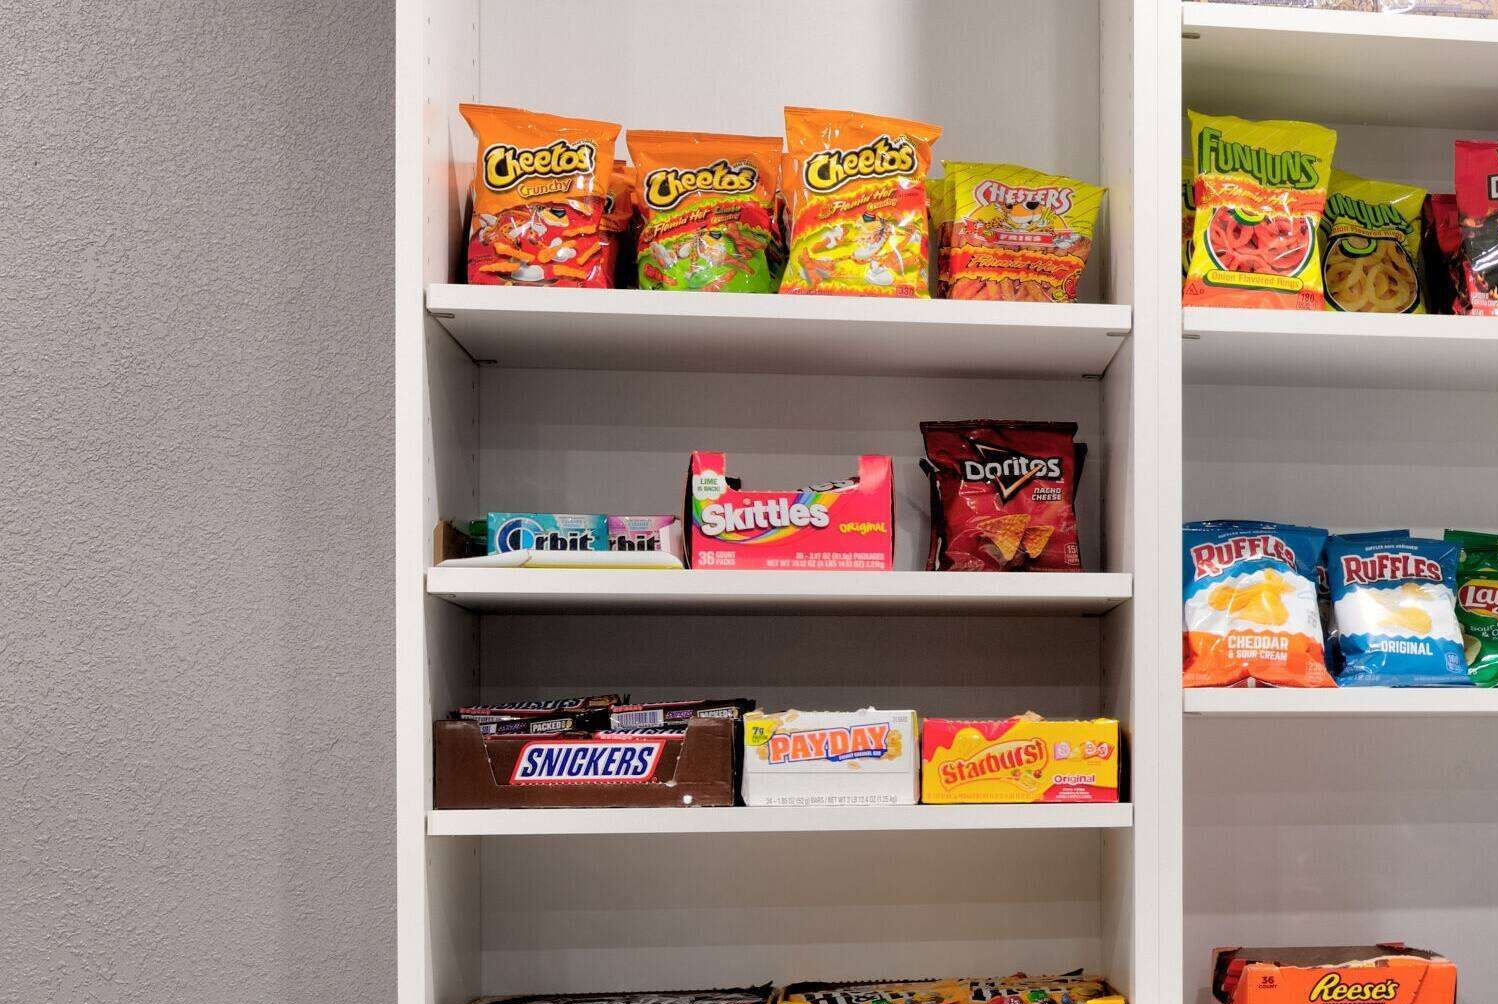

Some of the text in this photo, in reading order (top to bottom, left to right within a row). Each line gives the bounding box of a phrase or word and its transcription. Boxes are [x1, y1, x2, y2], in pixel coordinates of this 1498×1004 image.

[483, 140, 595, 191] Cheetos
[804, 135, 917, 193] Cheetos
[1200, 127, 1320, 190] FUNYUNS
[518, 178, 573, 199] Crunchy
[645, 159, 758, 209] Cheetos
[964, 457, 1062, 481] Doritos
[1033, 487, 1063, 495] NACHO
[701, 497, 830, 537] Skittles
[608, 534, 660, 551] rbit
[698, 551, 715, 566] 36
[1190, 534, 1297, 580] RUFFLES
[1342, 553, 1443, 585] RUFFLES
[1227, 635, 1289, 650] CHEDDAR
[1236, 650, 1257, 659] SOUR
[1259, 650, 1289, 661] CREAM
[1381, 640, 1434, 656] ORIGINAL
[532, 720, 561, 732] PACKED
[769, 723, 889, 763] PAYDAY
[520, 745, 654, 778] SNICKERS
[941, 740, 1046, 786] Starburst
[1053, 774, 1096, 785] Original
[1261, 976, 1275, 985] 36
[1308, 972, 1400, 1003] Reese's
